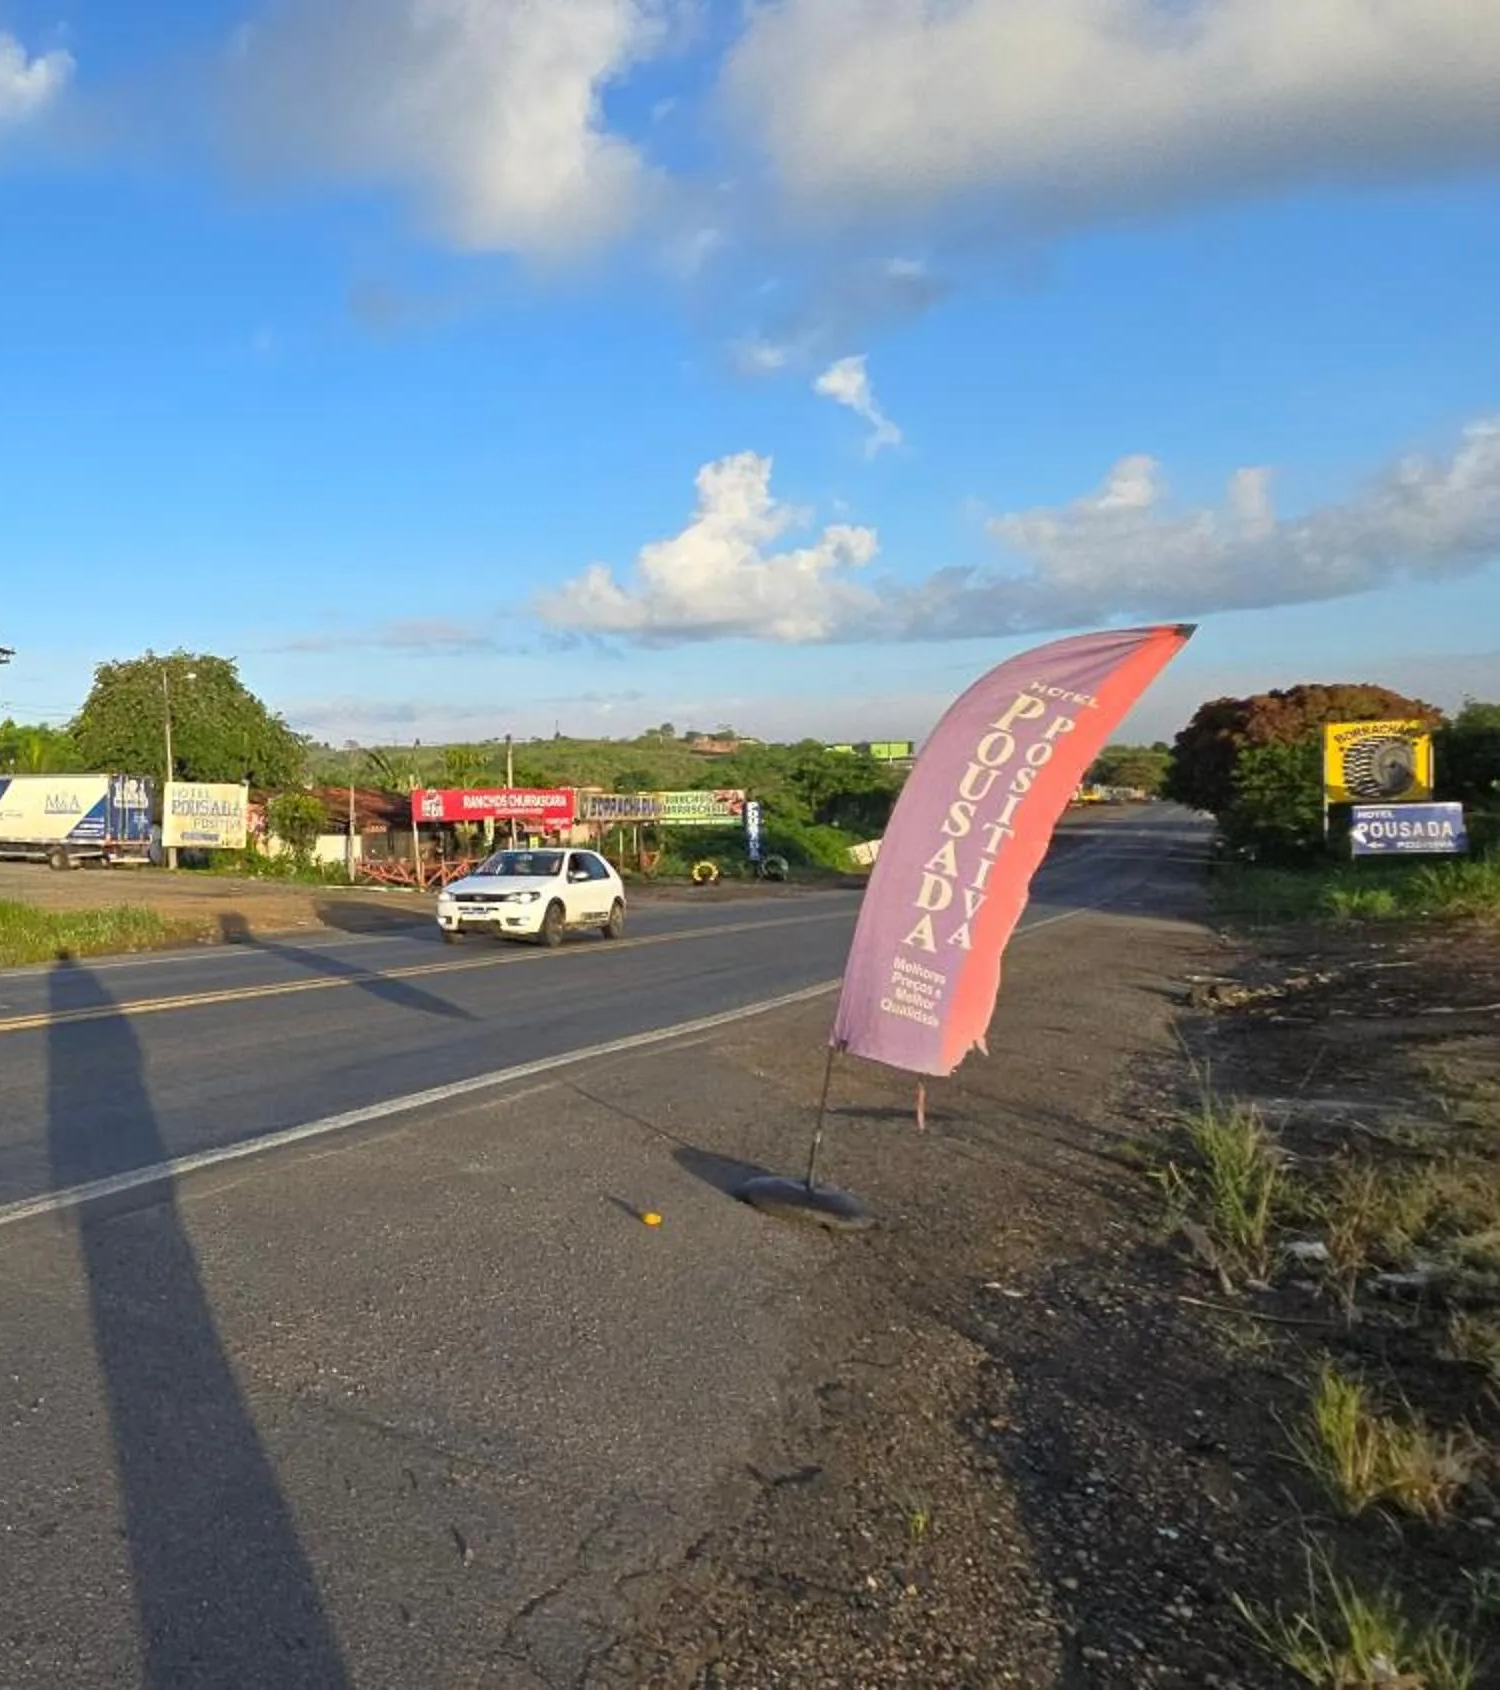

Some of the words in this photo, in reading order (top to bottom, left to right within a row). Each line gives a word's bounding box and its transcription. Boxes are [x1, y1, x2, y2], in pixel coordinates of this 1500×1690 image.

[1030, 682, 1099, 708] HOTEL
[171, 800, 242, 817] POUSADA
[1357, 810, 1394, 819] HOTEL
[901, 693, 1046, 953] POUSADA
[946, 716, 1077, 949] POSITIVA
[1356, 822, 1453, 840] POUSADA
